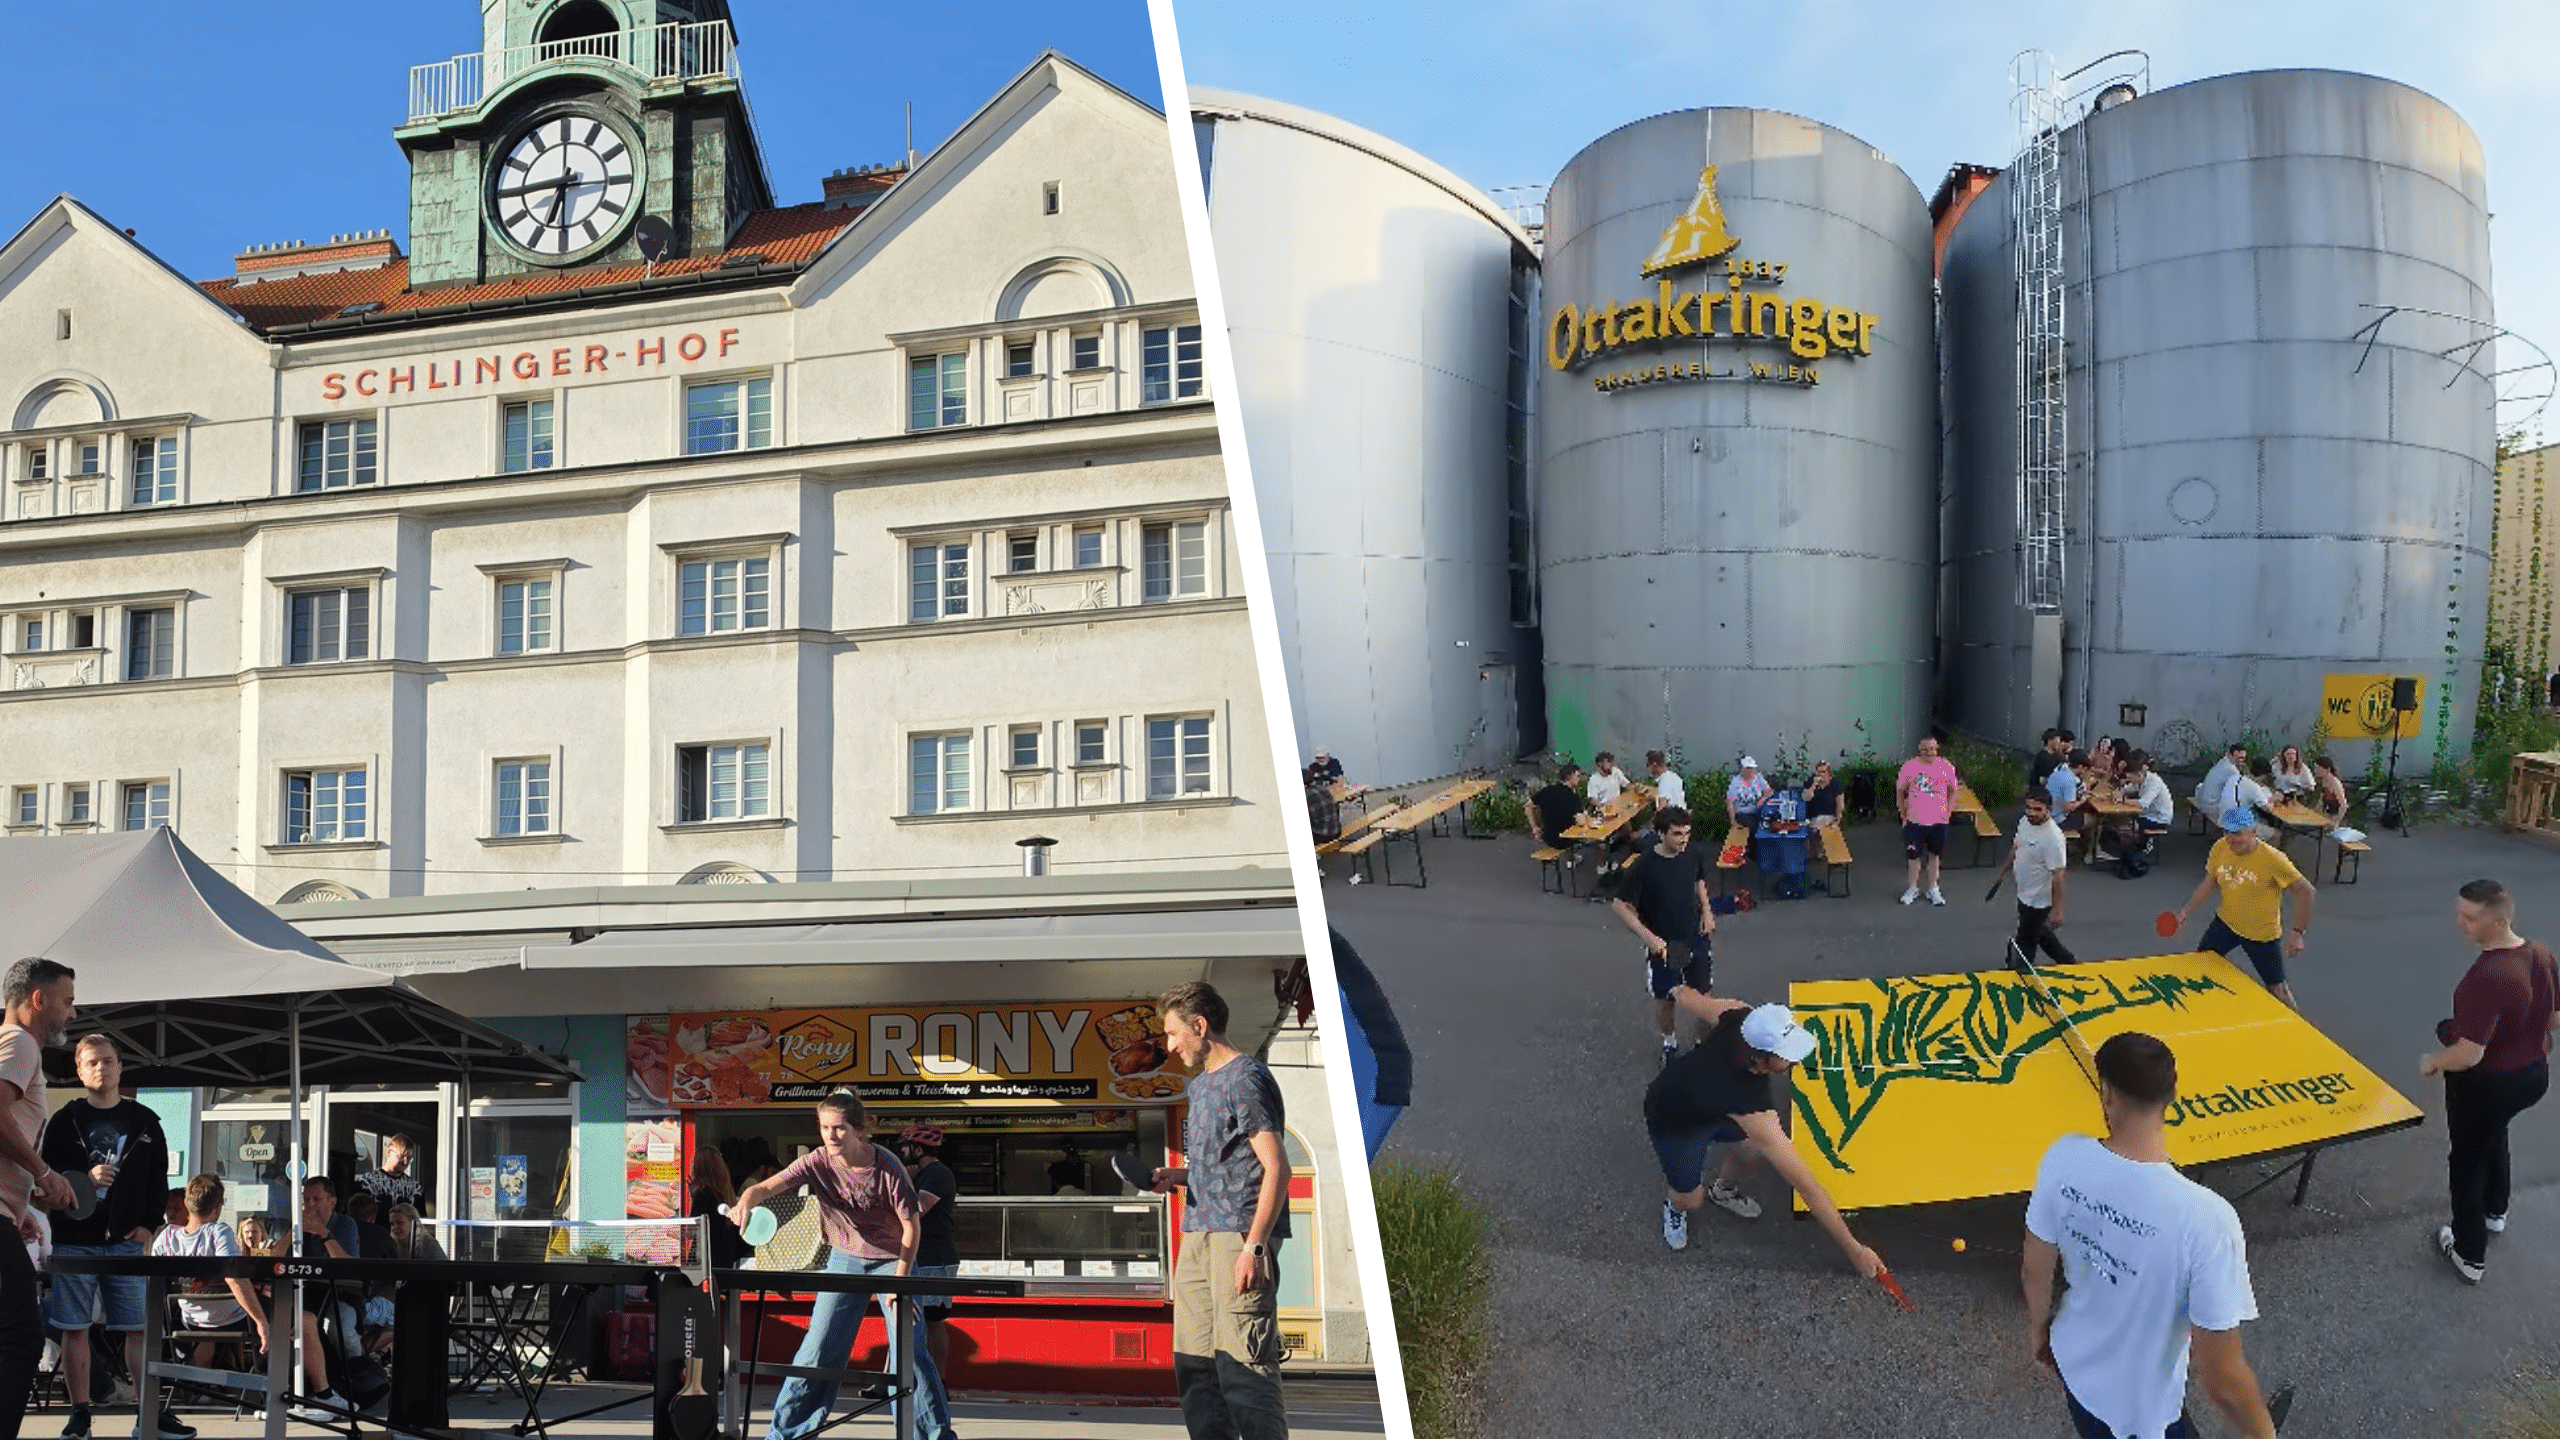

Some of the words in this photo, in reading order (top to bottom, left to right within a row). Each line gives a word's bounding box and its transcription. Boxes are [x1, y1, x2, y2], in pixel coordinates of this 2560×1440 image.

[1724, 259, 1789, 279] 1837
[1547, 277, 1880, 371] Ottakringer
[322, 328, 739, 399] SCHLINGER-HOF
[1749, 363, 1819, 386] WIEN
[2328, 698, 2351, 715] WC
[775, 1035, 854, 1063] Rony
[868, 1010, 1092, 1076] RONY
[775, 1085, 829, 1098] Grillhendl
[902, 1084, 911, 1096] &
[914, 1083, 971, 1096] Fleischerei
[245, 1147, 268, 1158] Open
[287, 1264, 313, 1275] 5-73
